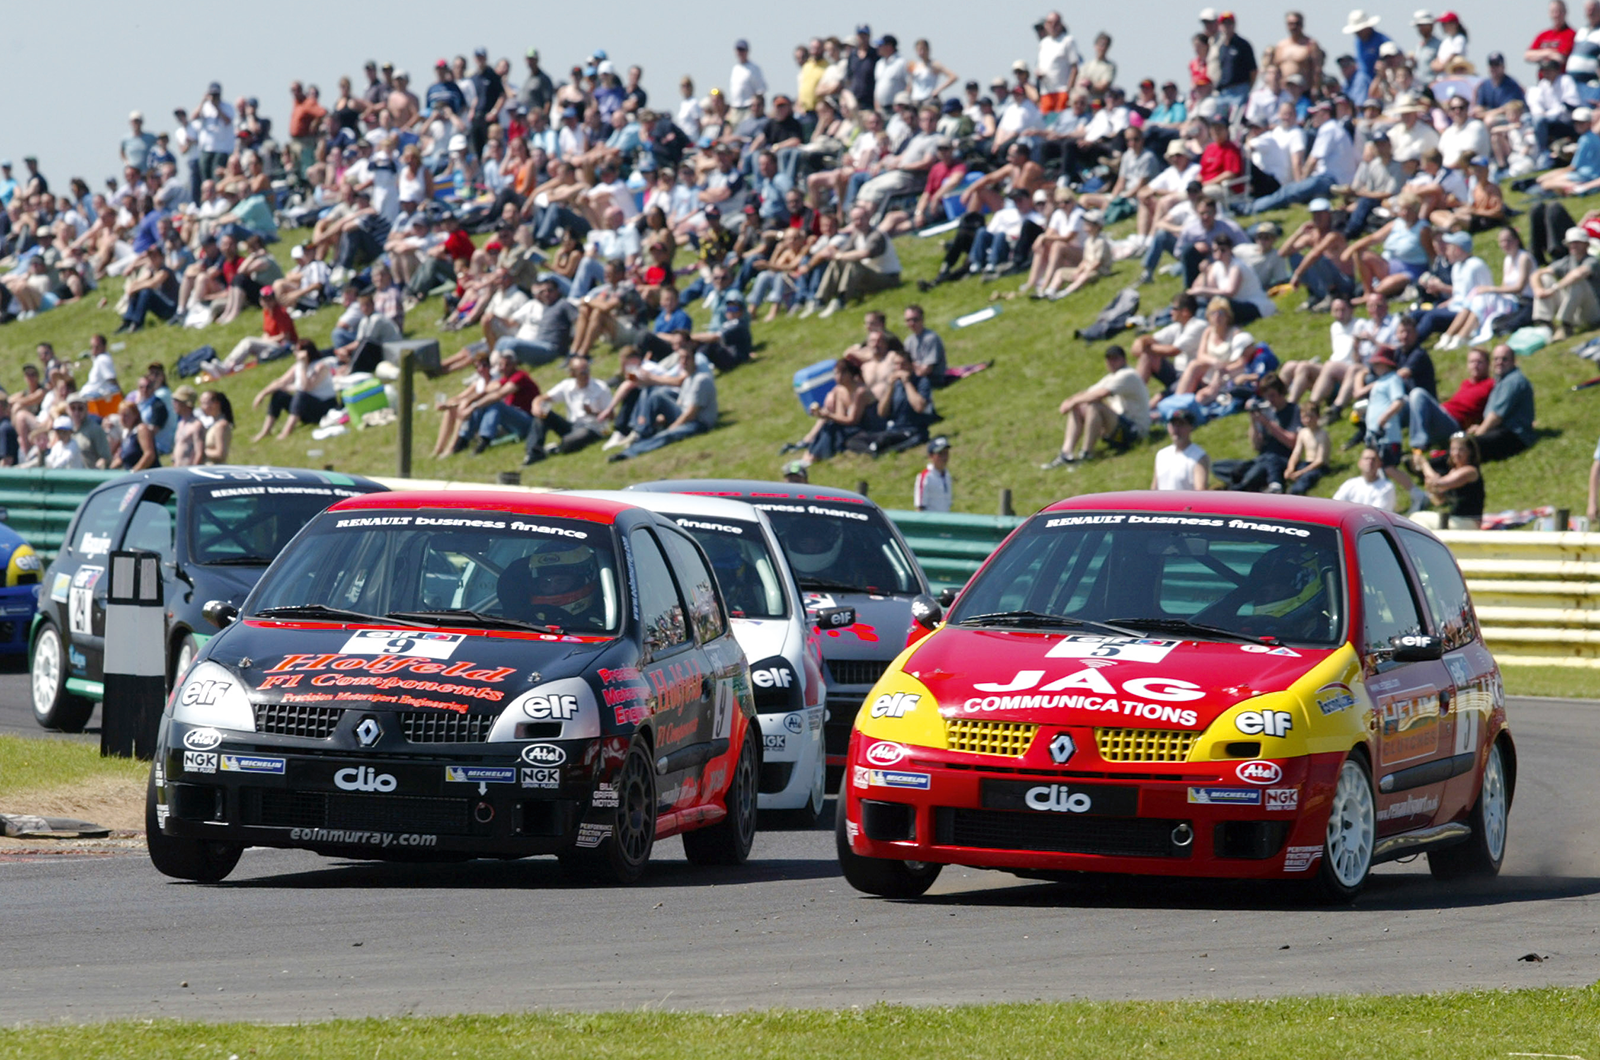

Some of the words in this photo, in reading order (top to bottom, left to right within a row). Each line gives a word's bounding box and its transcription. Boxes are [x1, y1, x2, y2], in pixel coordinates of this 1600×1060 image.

[210, 487, 265, 498] RENAULT
[267, 486, 333, 496] business
[333, 488, 367, 497] fina
[752, 503, 805, 513] siness
[808, 505, 869, 520] finance
[336, 517, 413, 528] RENAULT
[415, 516, 506, 529] business
[510, 521, 588, 539] finance
[676, 518, 743, 535] finance
[1045, 515, 1127, 528] RENAULT
[1128, 515, 1224, 527] business
[1228, 519, 1311, 538] finance
[831, 612, 852, 625] elf
[366, 631, 418, 639] elf
[1401, 635, 1431, 648] elf
[383, 638, 416, 654] 9
[1090, 643, 1125, 656] 5
[263, 653, 517, 683] Holfeld
[752, 667, 793, 688] elf
[972, 667, 1206, 702] JAG
[181, 679, 232, 706] elf
[256, 674, 304, 691] F1
[310, 673, 505, 701] Components
[280, 692, 334, 703] Precision
[335, 691, 398, 703] Motorsport
[398, 694, 469, 714] Engineering
[523, 694, 578, 720] elf
[871, 691, 921, 718] elf
[964, 694, 1198, 727] COMMUNICATIONS
[1235, 709, 1292, 738] elf
[184, 753, 216, 768] NGK
[240, 760, 283, 769] MICHELIN
[334, 765, 398, 792] Clio
[522, 769, 558, 782] NGK
[886, 774, 928, 783] MICHELIN
[599, 783, 614, 791] BILL
[1210, 791, 1258, 799] MICHELIN
[592, 799, 619, 807] MOTORS
[1025, 784, 1091, 813] Clio
[1267, 790, 1297, 804] NGK
[290, 827, 438, 848] eoinmurray.com
